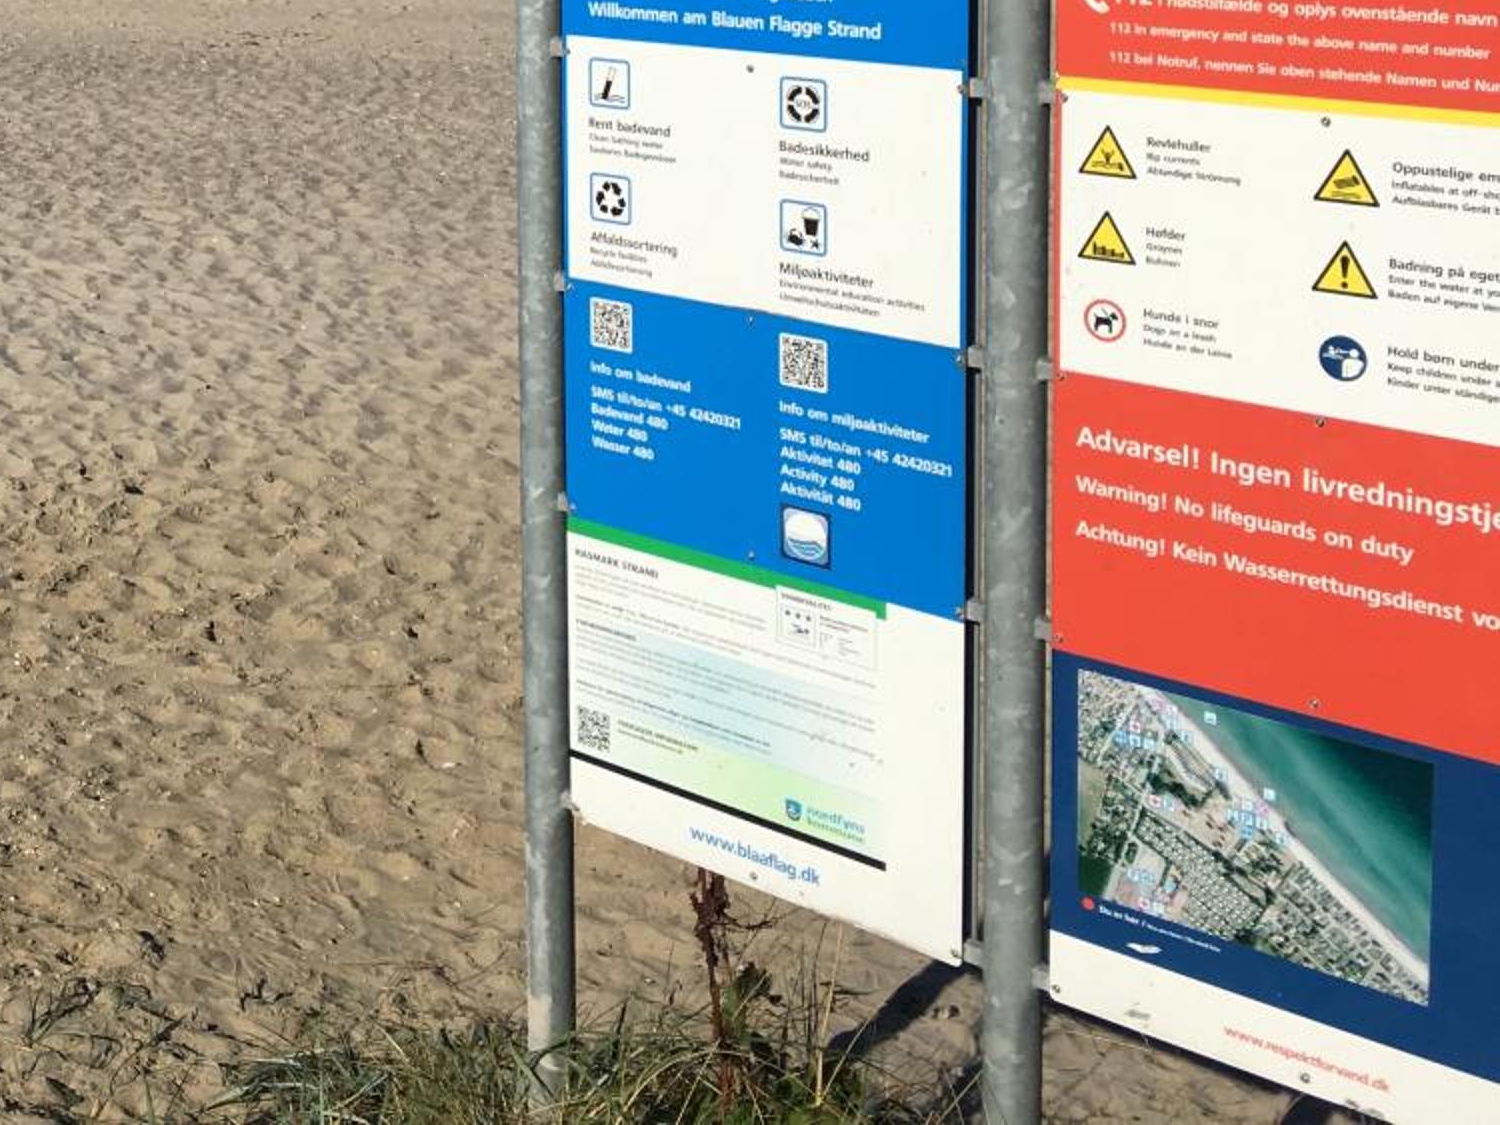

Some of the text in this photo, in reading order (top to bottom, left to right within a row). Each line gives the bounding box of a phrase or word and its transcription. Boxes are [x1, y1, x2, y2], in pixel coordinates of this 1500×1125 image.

[589, 3, 881, 40] Willkommen am Blauen Flagge Strand
[1268, 3, 1289, 17] og
[1294, 2, 1336, 20] oplys
[1342, 5, 1449, 24] ovenstående
[1455, 13, 1498, 27] navn
[1110, 22, 1491, 60] 112 in emergency and state the above name and number
[1109, 51, 1131, 64] 112
[1134, 54, 1153, 66] bei
[1157, 55, 1201, 70] Notruf,
[1205, 60, 1253, 74] nennen
[1257, 63, 1276, 75] Sie
[1281, 65, 1315, 79] oben
[1319, 67, 1381, 83] stehende
[1386, 71, 1437, 87] Namen
[1441, 77, 1470, 90] und
[589, 117, 670, 137] Rent badevand
[779, 141, 869, 161] Badesikkerhed
[1393, 161, 1473, 181] Oppustelige
[591, 231, 677, 258] Affaldssortering
[780, 262, 874, 288] Miljøaktiviteter
[1389, 258, 1443, 277] Badning
[1448, 263, 1464, 278] på
[1388, 289, 1420, 301] Baden
[1424, 295, 1441, 304] auf
[1389, 275, 1415, 286] Enter
[1420, 280, 1436, 288] the
[1440, 282, 1469, 292] water
[1473, 287, 1483, 295] at
[1143, 309, 1181, 323] Hunde
[1193, 317, 1219, 329] snor
[1388, 346, 1500, 372] Hold børn under
[590, 360, 691, 393] Info om badevand
[1387, 362, 1491, 385] Keep children under
[1387, 376, 1420, 389] Kinder
[591, 385, 614, 401] SMS
[666, 403, 686, 417] +45
[591, 403, 644, 424] Badevand
[591, 419, 624, 436] Water
[779, 400, 930, 444] Info om miljøaktiviteter
[779, 428, 952, 477] SMS til/to/an +45 42420321
[1076, 426, 1199, 469] Advarsel!
[1211, 451, 1291, 488] Ingen
[780, 465, 855, 491] Activity 480
[837, 460, 861, 475] 480
[837, 496, 861, 511] 480
[1076, 475, 1413, 565] Warning! No lifeguards on duty
[575, 548, 618, 567] HASMARK
[1076, 521, 1165, 557] Achtung!
[1173, 541, 1217, 566] Kein
[1223, 552, 1462, 623] Wasserrettungsdienst
[690, 827, 820, 883] www.blaaflag.dk
